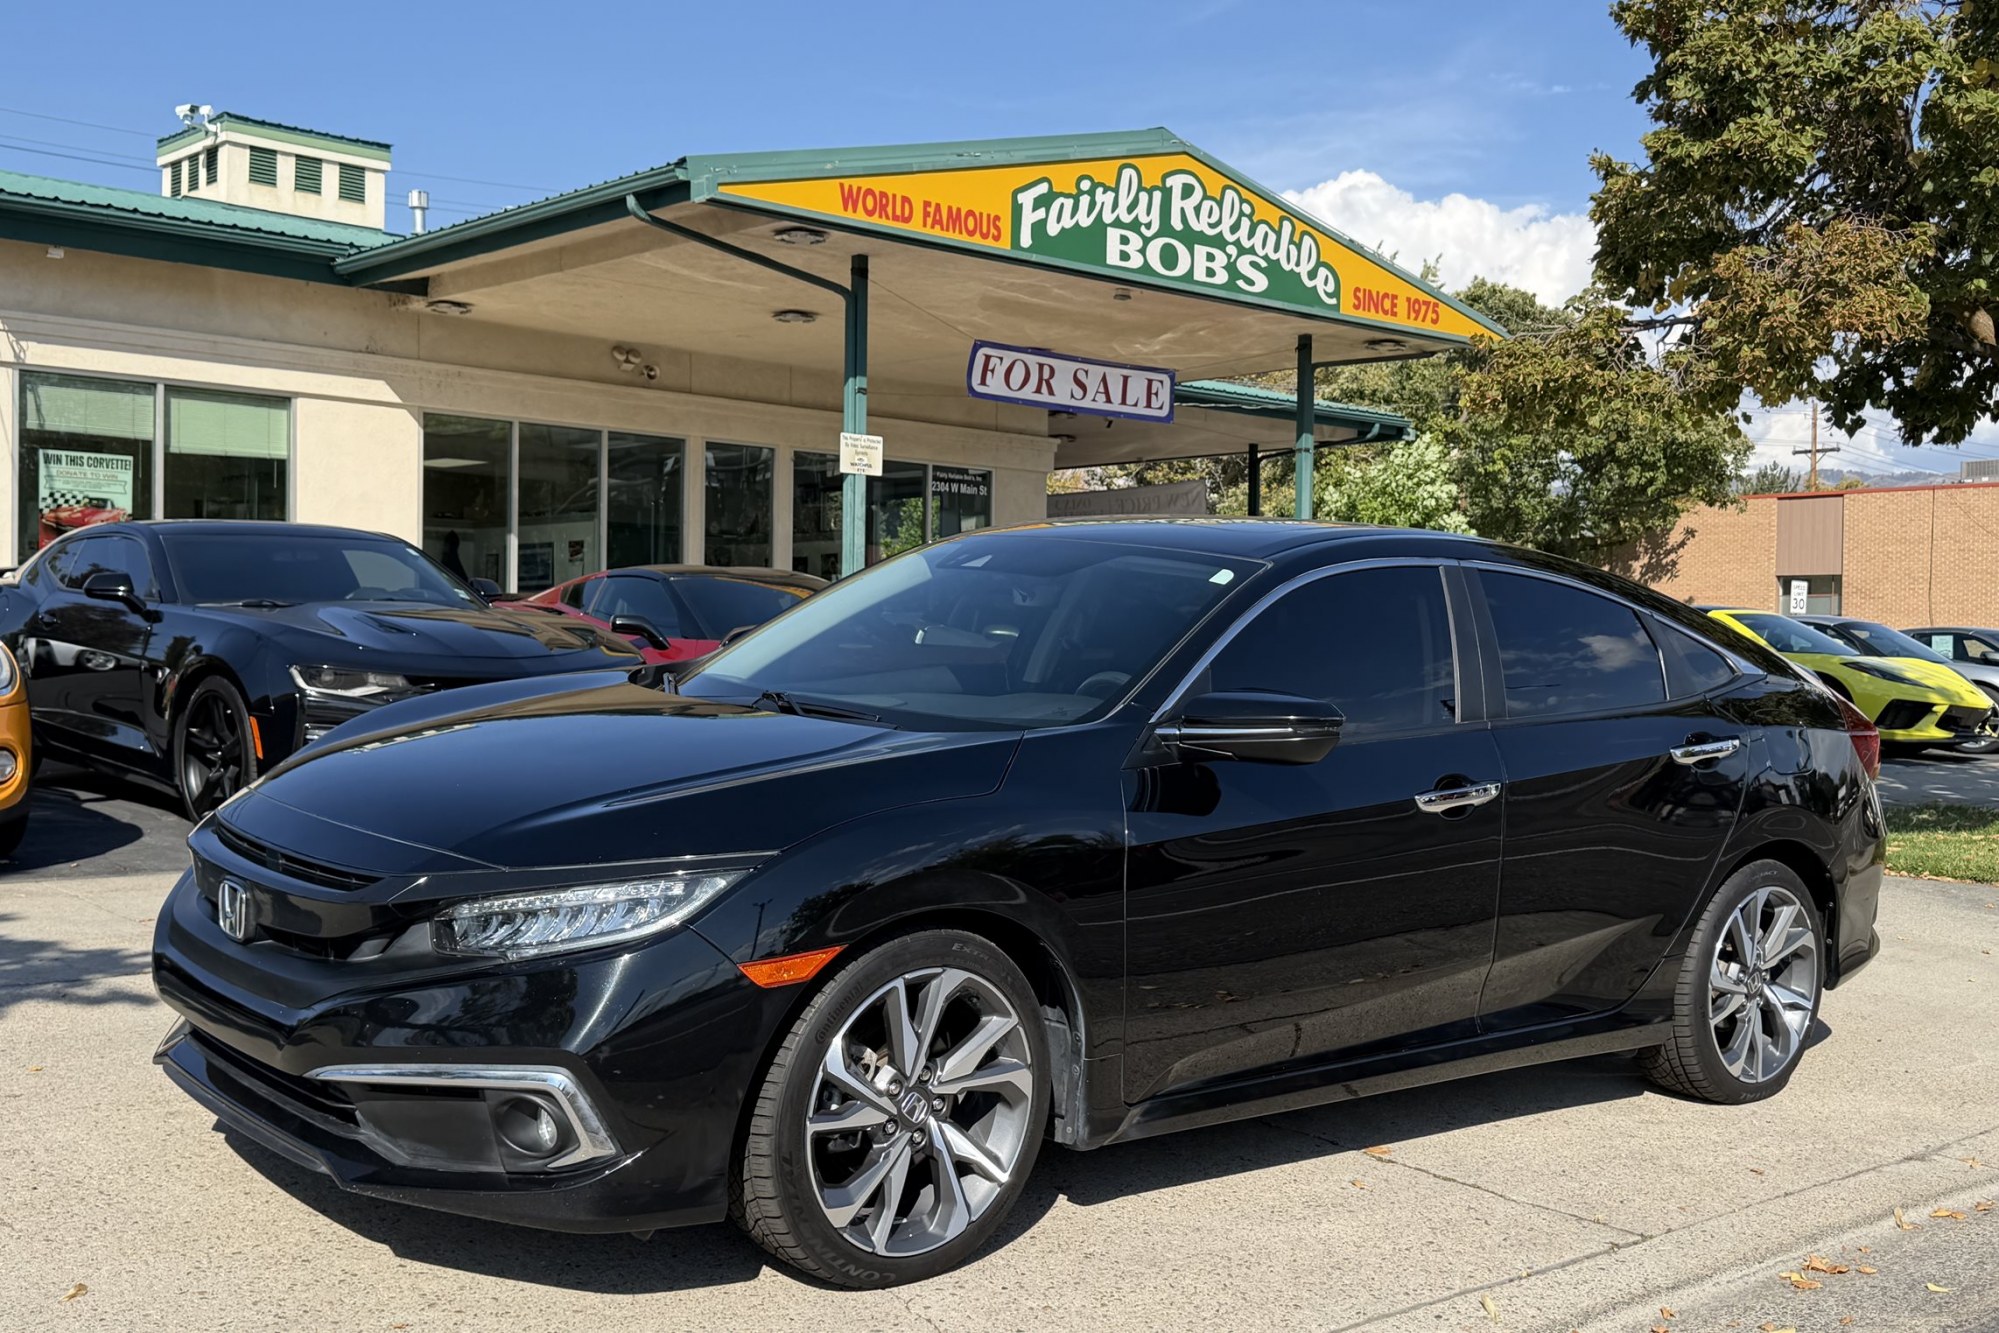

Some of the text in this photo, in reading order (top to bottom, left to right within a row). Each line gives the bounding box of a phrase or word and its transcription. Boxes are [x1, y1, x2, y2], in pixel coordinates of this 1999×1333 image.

[839, 182, 1002, 242] WORLD FAMOUS
[1017, 167, 1337, 305] Fairly Reliable
[1106, 226, 1269, 293] BOB'S
[1352, 286, 1440, 325] SINCE 1975
[977, 353, 1165, 411] FOR SALE
[43, 452, 132, 471] WIN THIS CORVETTE!
[931, 481, 988, 496] 2304 W Main St
[1792, 598, 1804, 610] 30
